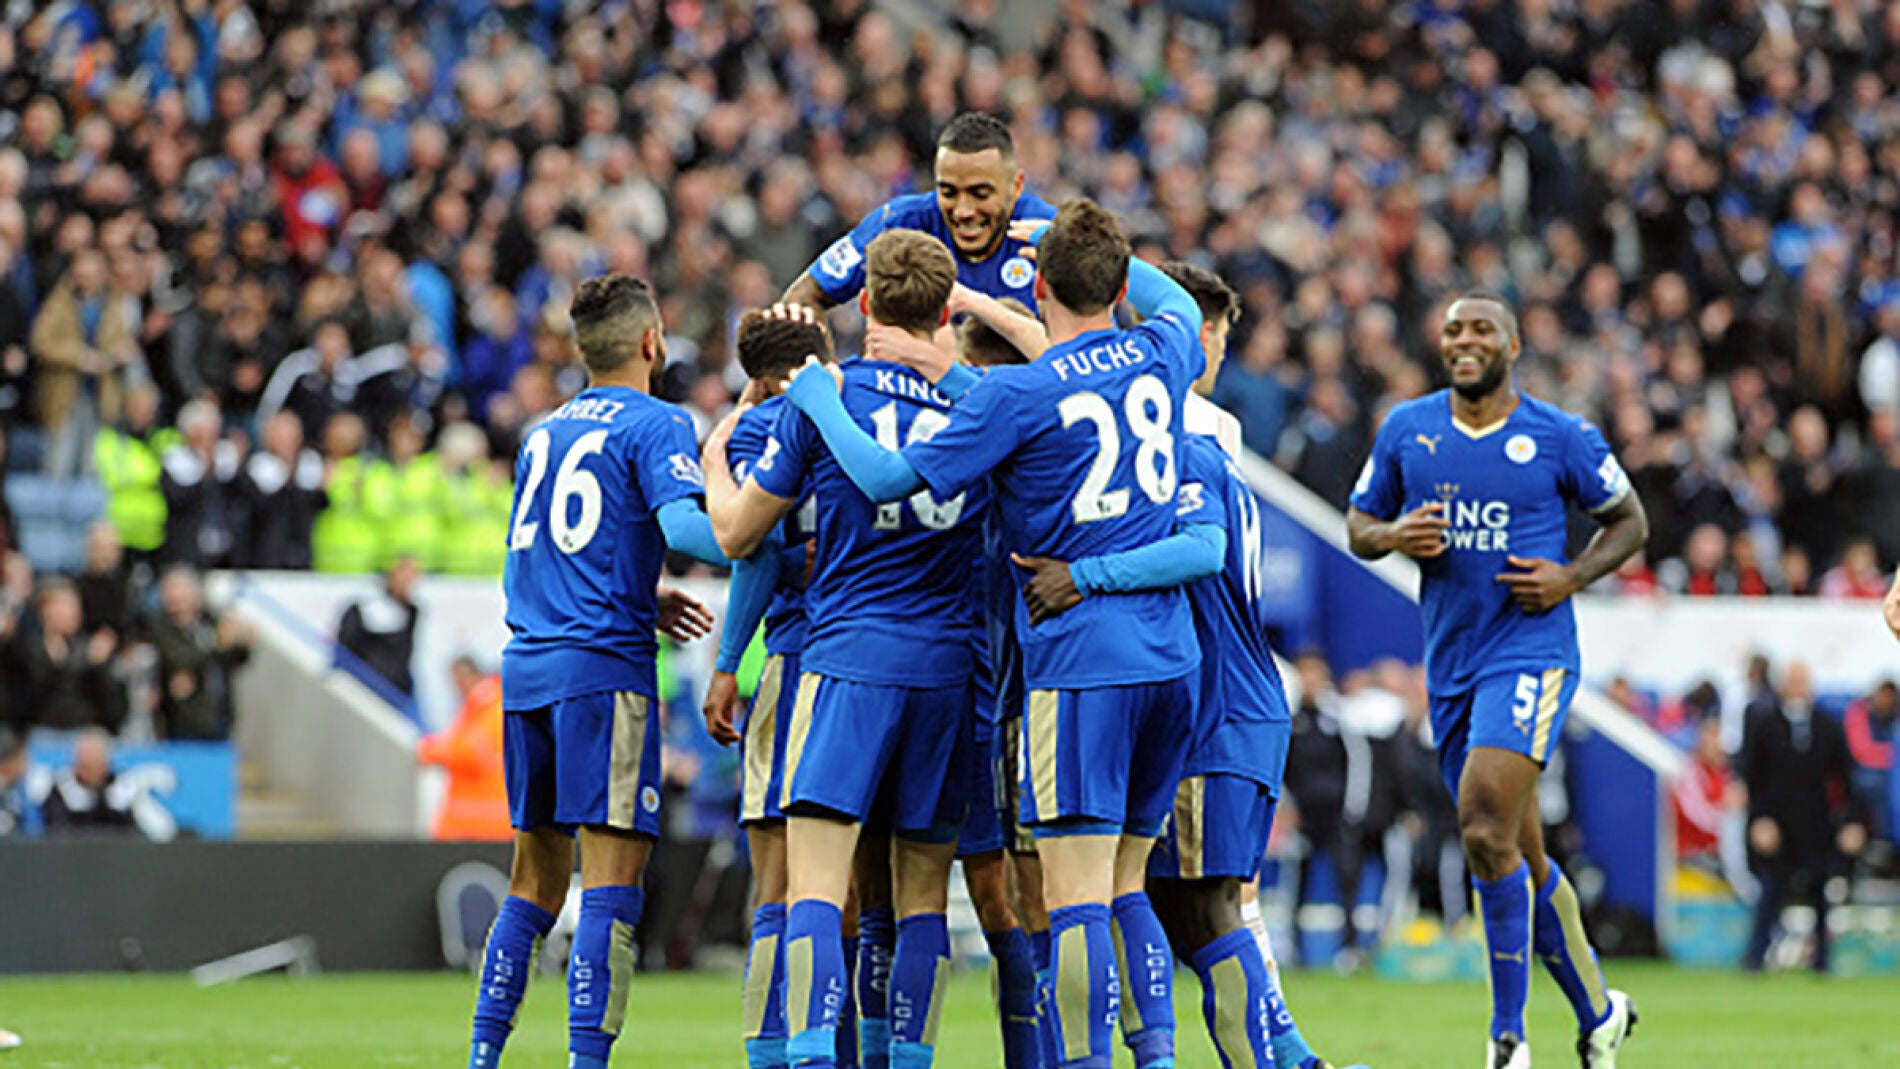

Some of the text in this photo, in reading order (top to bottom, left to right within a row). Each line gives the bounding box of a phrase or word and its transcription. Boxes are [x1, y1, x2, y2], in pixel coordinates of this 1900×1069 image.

[1050, 339, 1145, 381] FUCHS
[1057, 373, 1176, 525] 28
[511, 428, 608, 555] 26
[1440, 529, 1509, 551] OWER
[1511, 673, 1539, 720] 5
